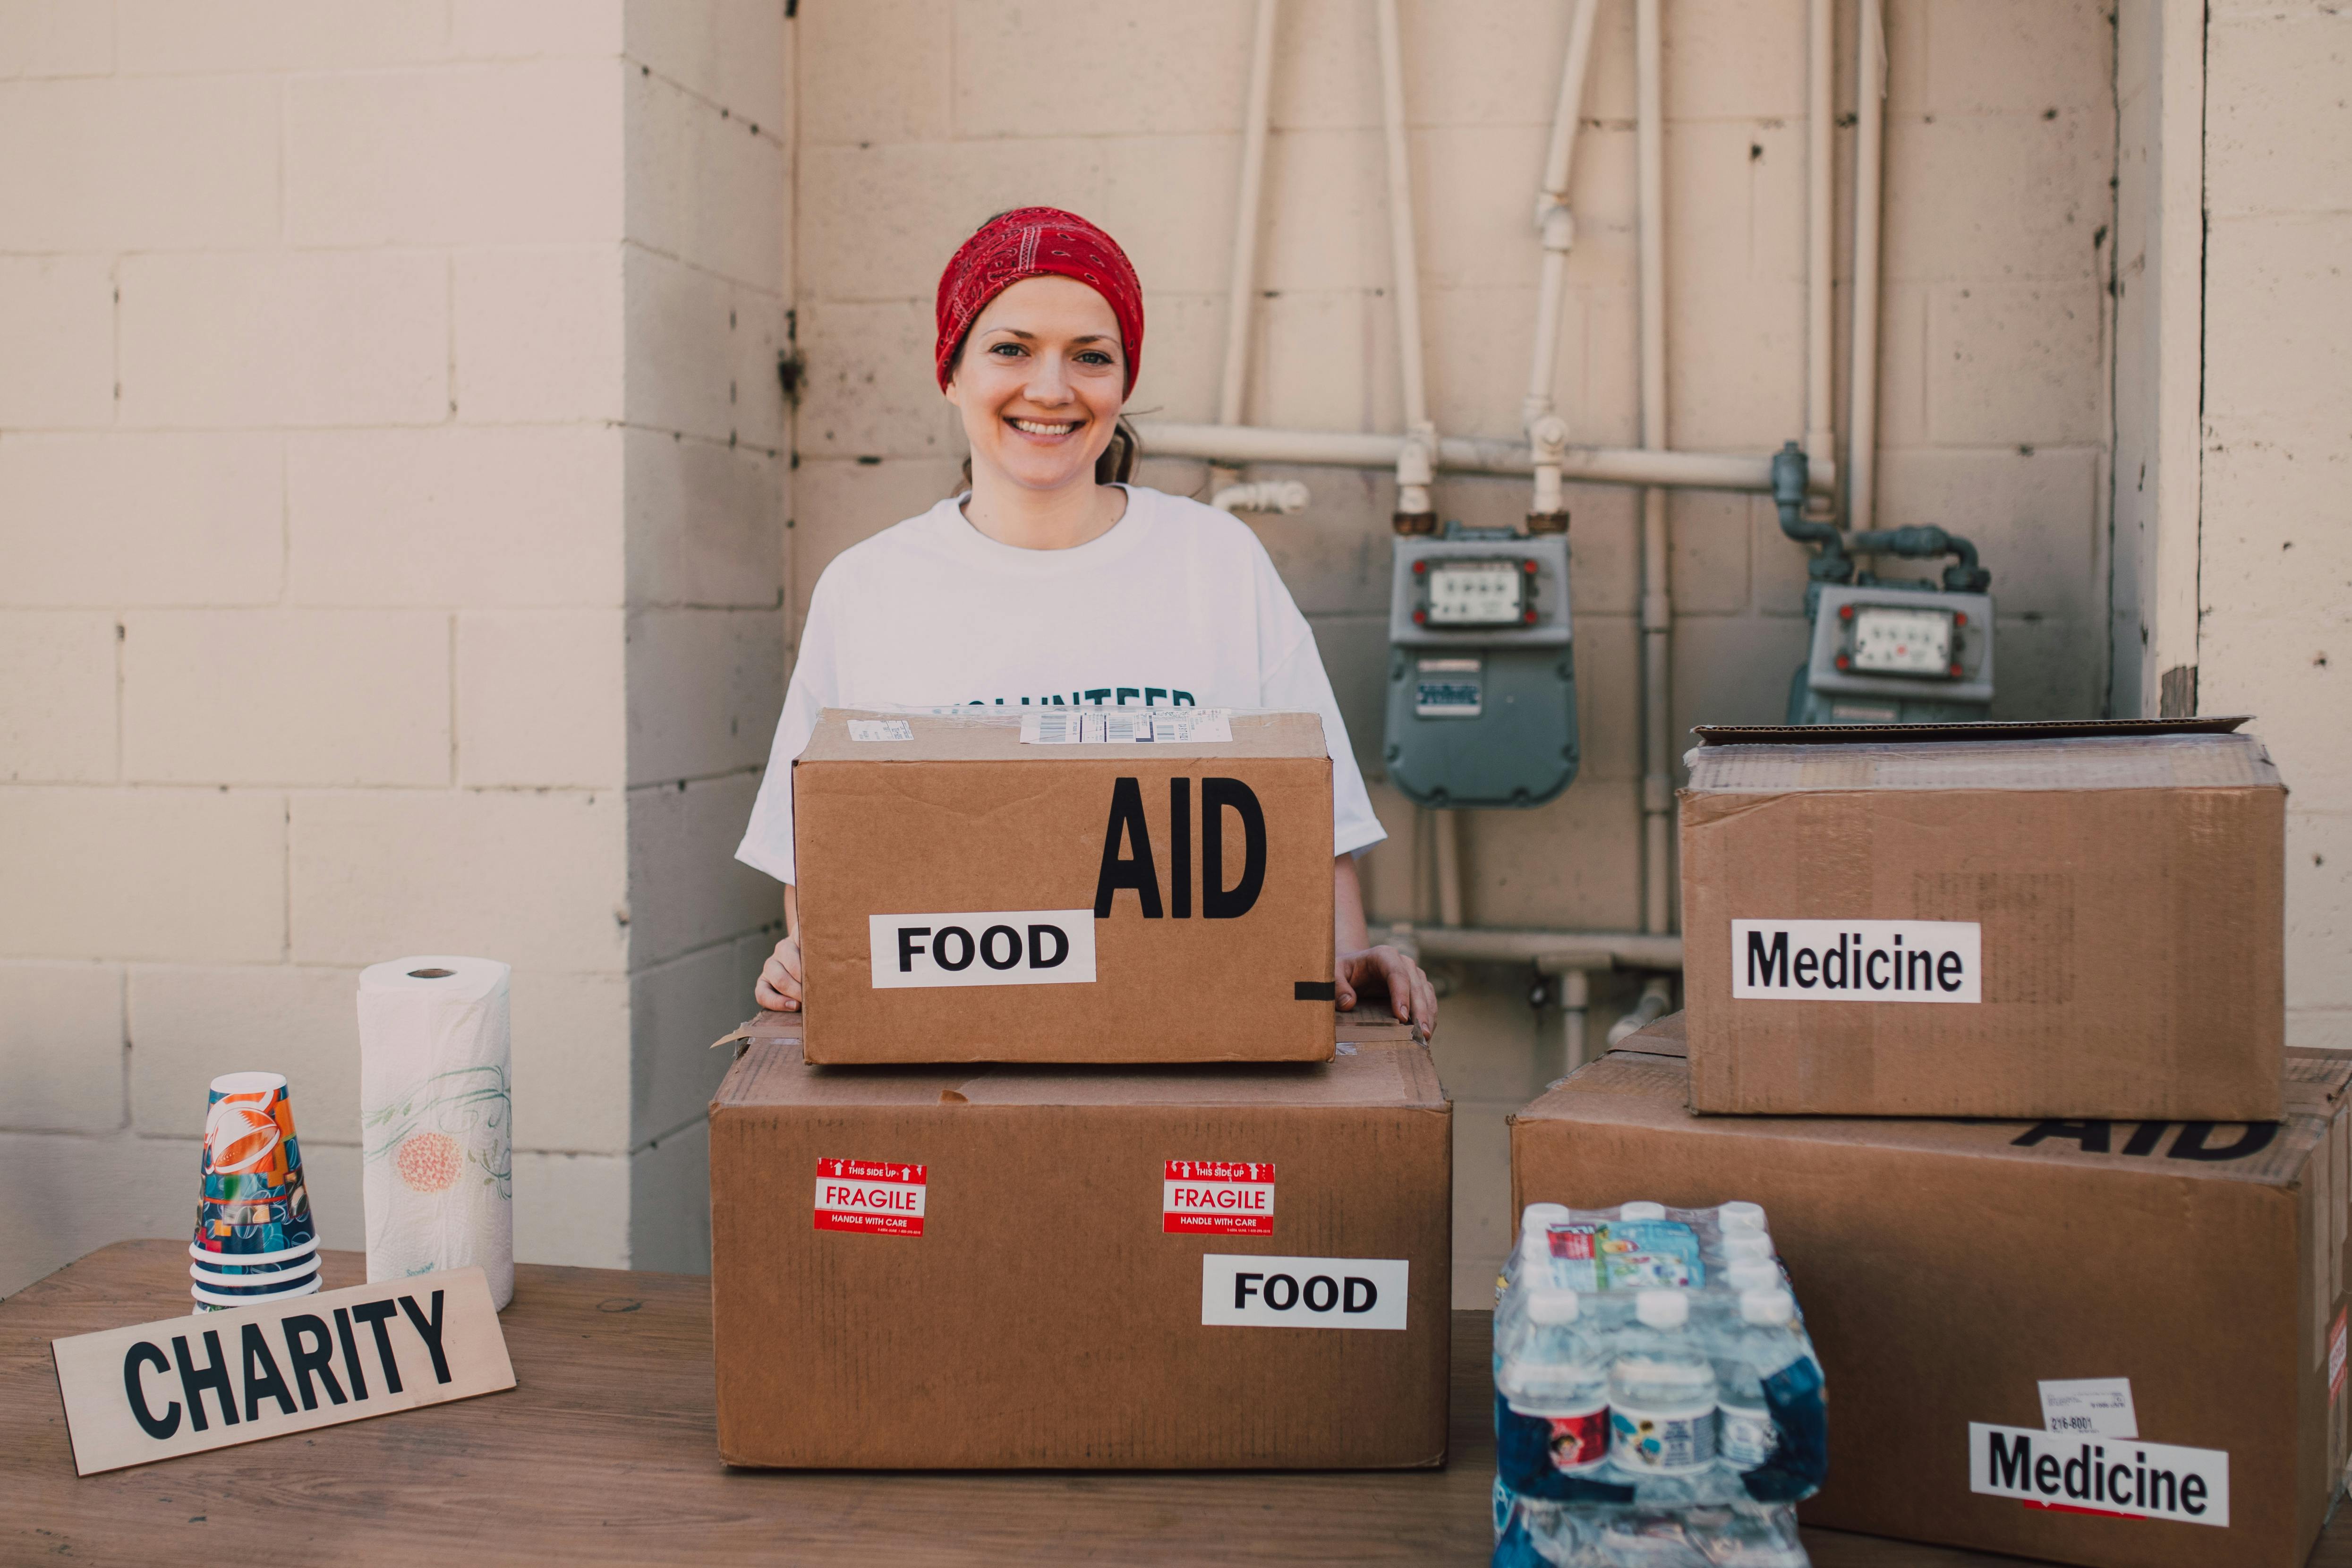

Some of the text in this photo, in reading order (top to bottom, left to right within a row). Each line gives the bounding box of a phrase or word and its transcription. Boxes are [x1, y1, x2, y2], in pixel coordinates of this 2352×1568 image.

[1094, 777, 1266, 919] AID
[898, 925, 1069, 971] FOOD
[1748, 931, 1962, 991] Medicine
[849, 1167, 896, 1177] THIS SIDE UP
[1214, 1169, 1231, 1177] SIDE
[827, 1186, 917, 1210] FRAGILE
[1175, 1188, 1265, 1209] FRAGILE
[832, 1214, 907, 1227] HANDLE WITH CARE
[1181, 1217, 1256, 1227] HANDLE WITH CARE
[1235, 1273, 1377, 1312] FOOD
[124, 1290, 452, 1439] CHARITY
[2052, 1417, 2093, 1430] 216-8001
[1990, 1432, 2207, 1515] Medicine
